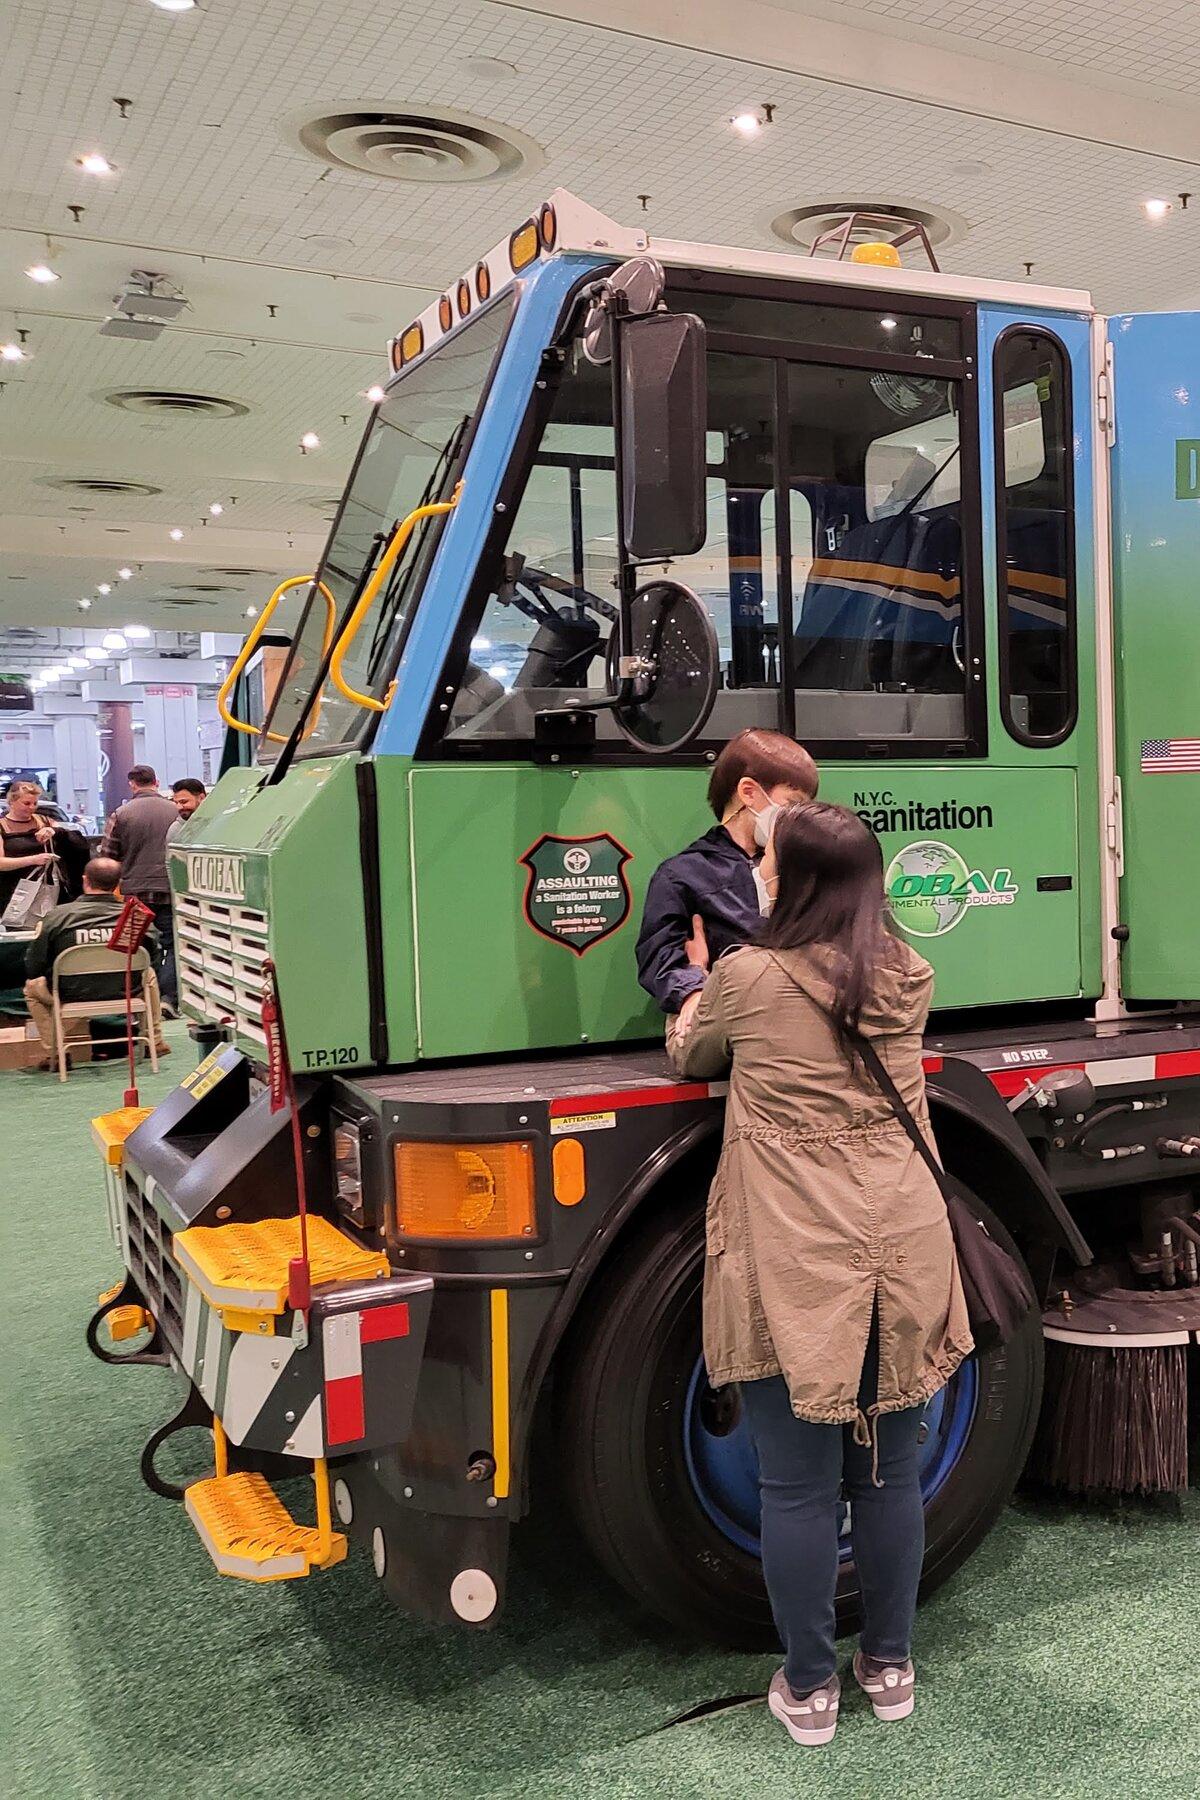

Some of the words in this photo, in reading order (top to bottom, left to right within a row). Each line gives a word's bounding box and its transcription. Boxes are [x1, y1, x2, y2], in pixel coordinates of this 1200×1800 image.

[853, 791, 897, 807] N.Y.C.
[855, 800, 993, 833] sanitation
[537, 876, 618, 889] ASSAULTING
[890, 871, 1017, 897] OBAL
[535, 894, 542, 902] a
[543, 892, 587, 902] Sanitation
[589, 890, 620, 900] Worker
[948, 895, 1013, 905] PRODUCTS
[556, 905, 565, 914] is
[566, 906, 573, 914] a
[574, 904, 602, 915] felony
[76, 928, 114, 945] DSN
[302, 1046, 359, 1068] T.P.120
[1002, 1051, 1020, 1063] NO
[1021, 1048, 1048, 1061] STEP
[563, 1114, 604, 1124] ATTENTION
